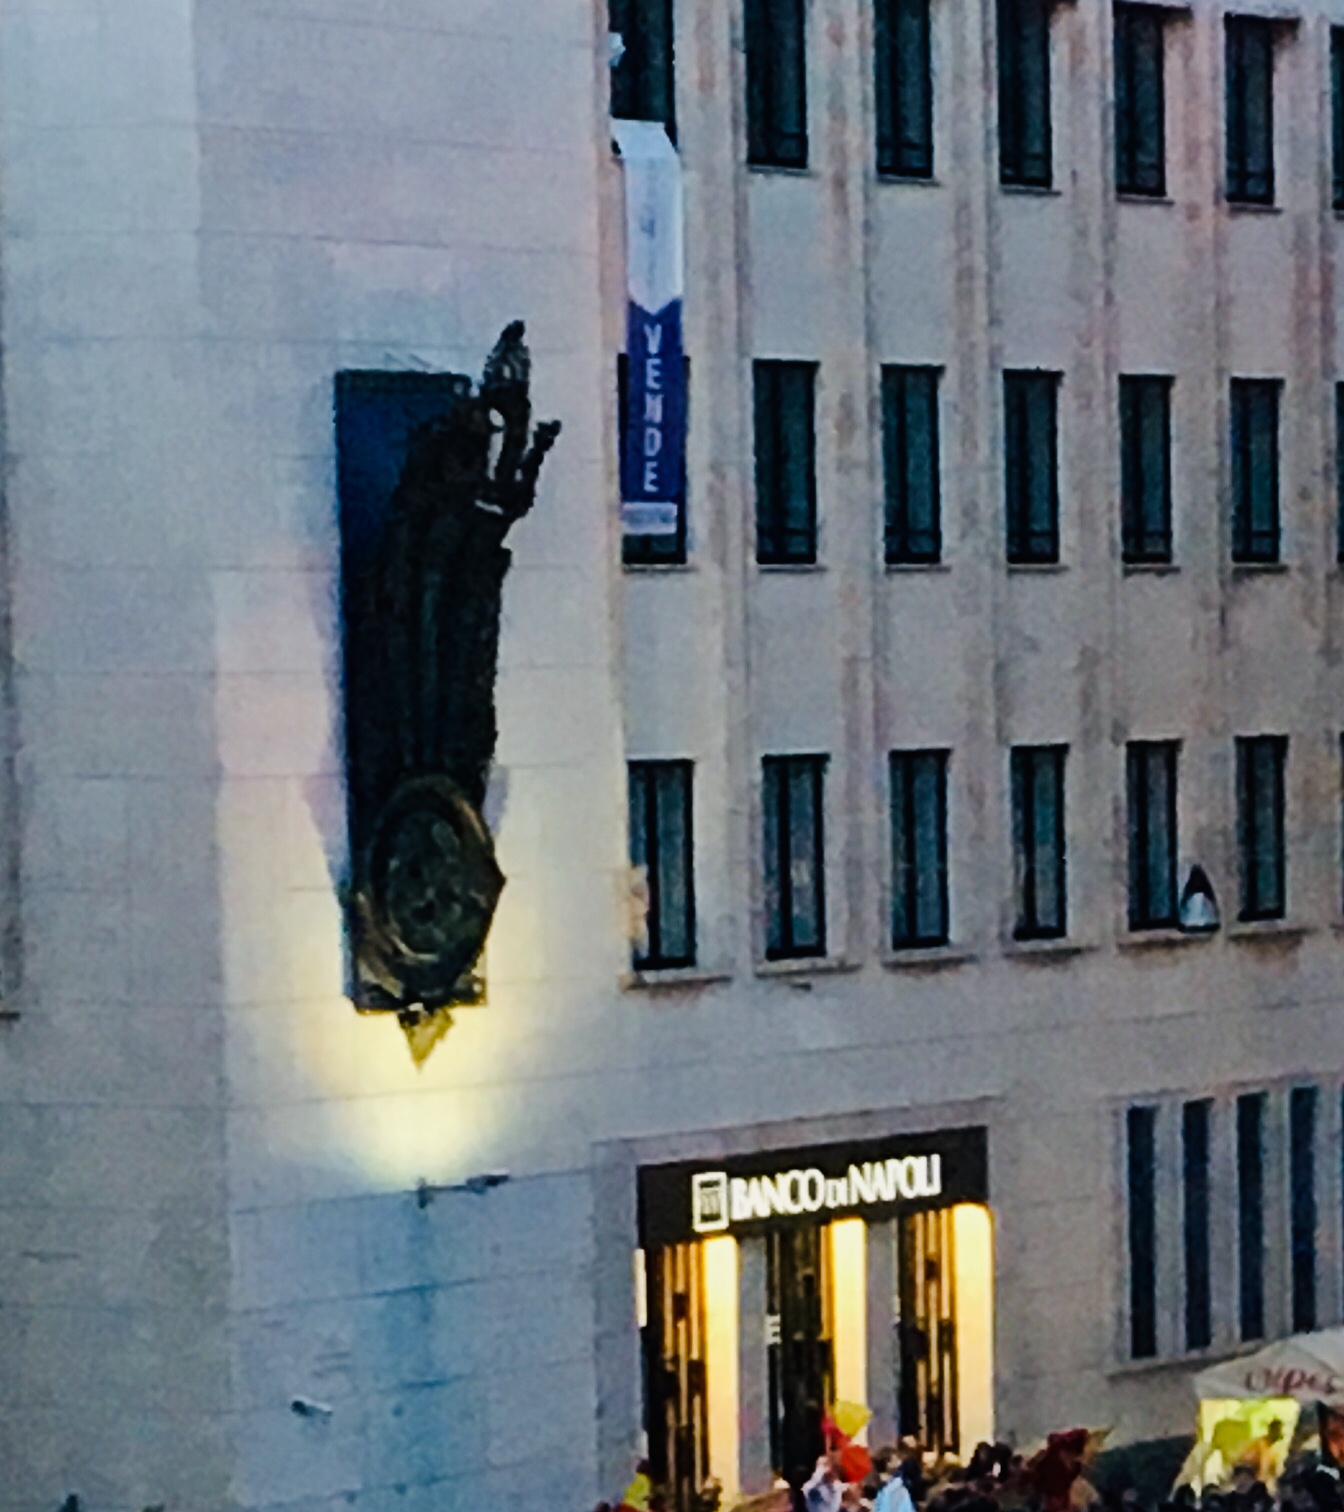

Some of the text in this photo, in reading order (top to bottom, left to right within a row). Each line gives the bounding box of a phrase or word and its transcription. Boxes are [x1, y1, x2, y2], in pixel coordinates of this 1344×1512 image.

[643, 322, 664, 493] VENDE
[730, 1168, 825, 1221] BANCO
[848, 1153, 942, 1204] NAPOLI
